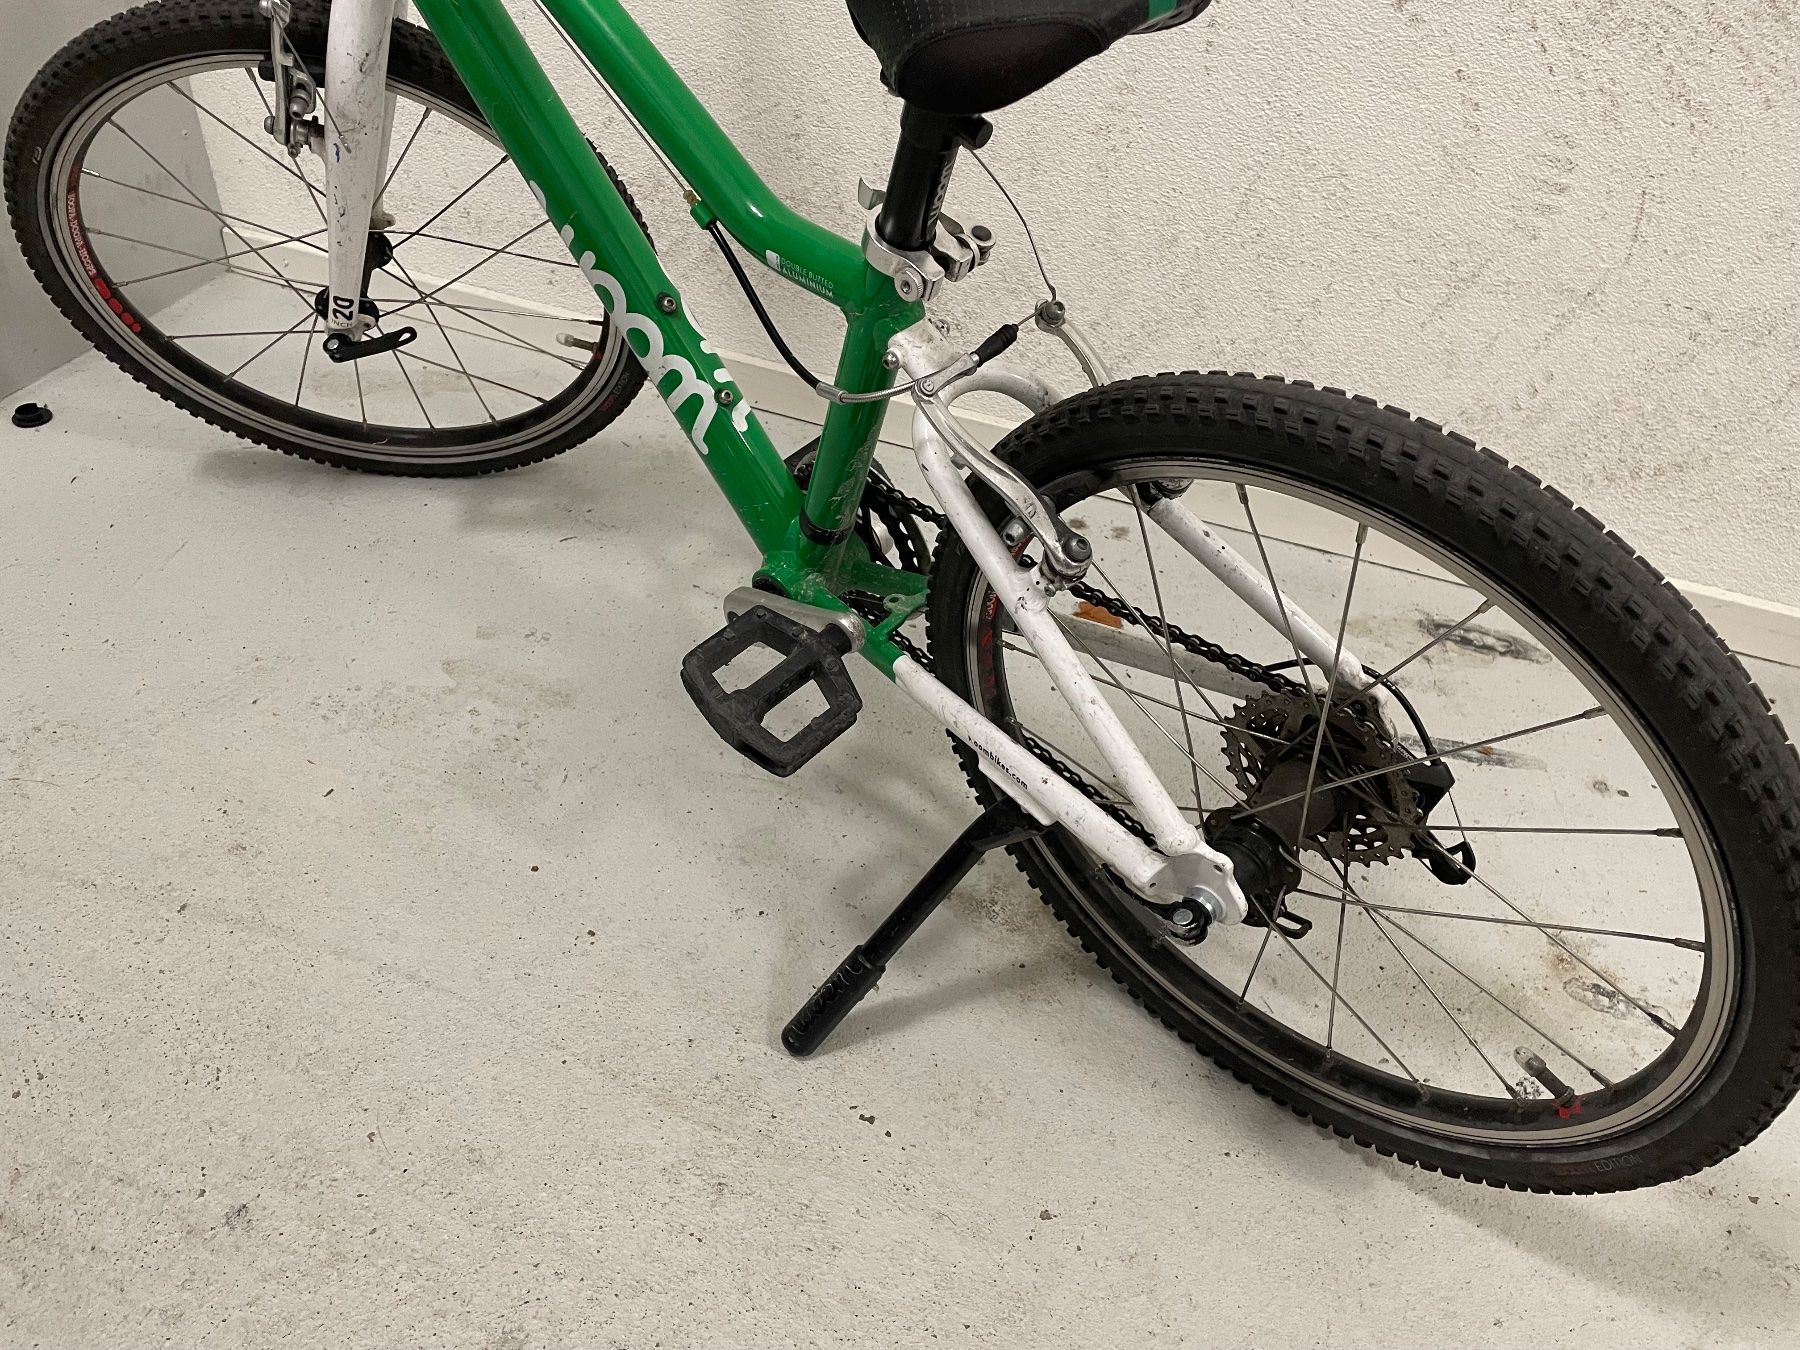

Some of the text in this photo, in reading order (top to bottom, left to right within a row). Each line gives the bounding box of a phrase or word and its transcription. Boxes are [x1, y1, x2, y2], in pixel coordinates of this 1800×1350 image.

[781, 257, 807, 276] DOUBLE
[808, 271, 834, 290] BUTTED
[782, 267, 834, 299] ALUMINIUM
[332, 295, 355, 321] 20
